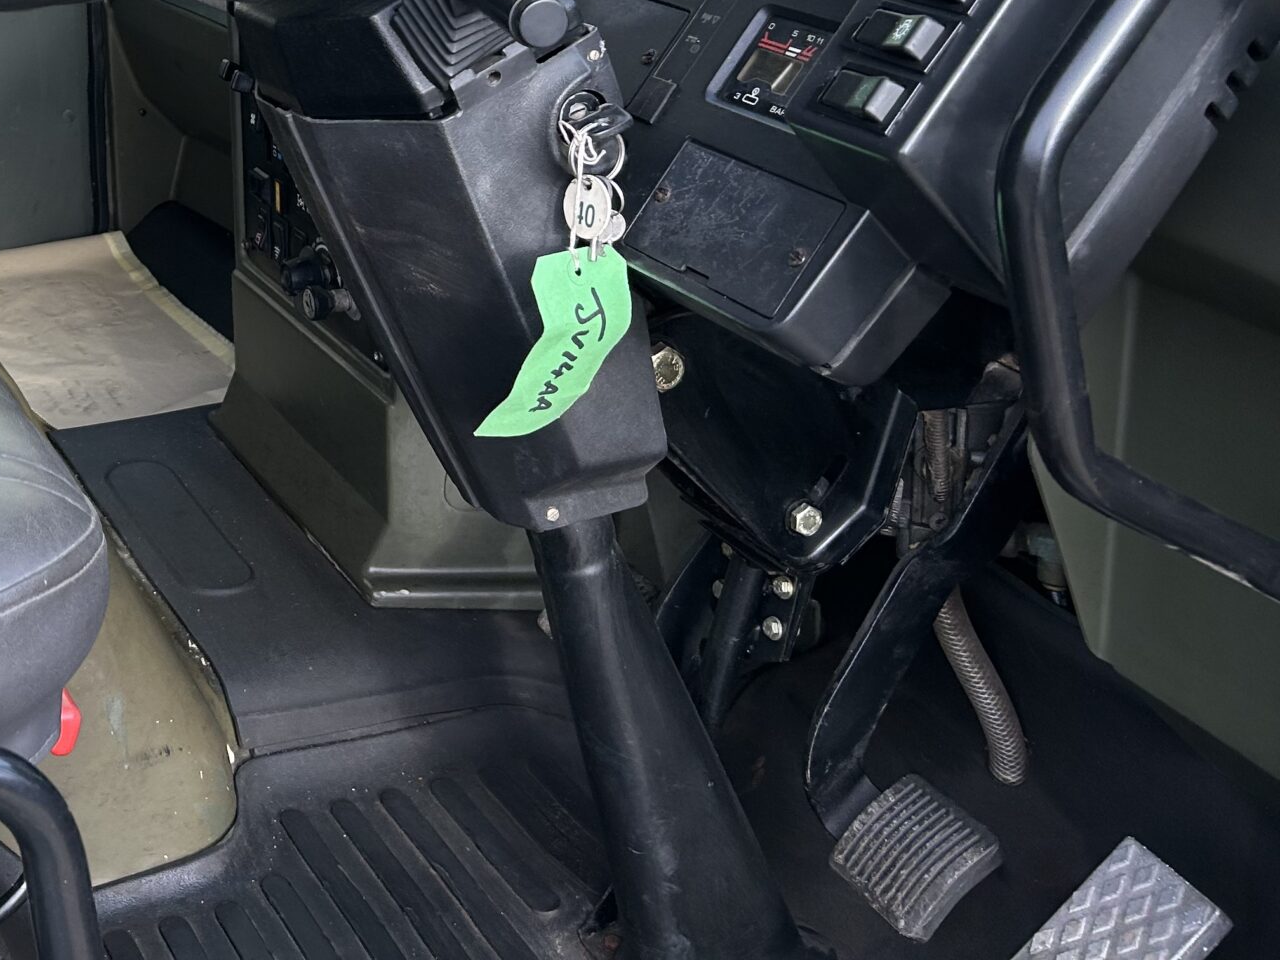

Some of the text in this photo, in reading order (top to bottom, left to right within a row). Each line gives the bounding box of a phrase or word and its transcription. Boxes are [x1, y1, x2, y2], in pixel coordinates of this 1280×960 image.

[806, 34, 816, 42] 10
[816, 37, 824, 45] 11
[733, 92, 741, 100] 3
